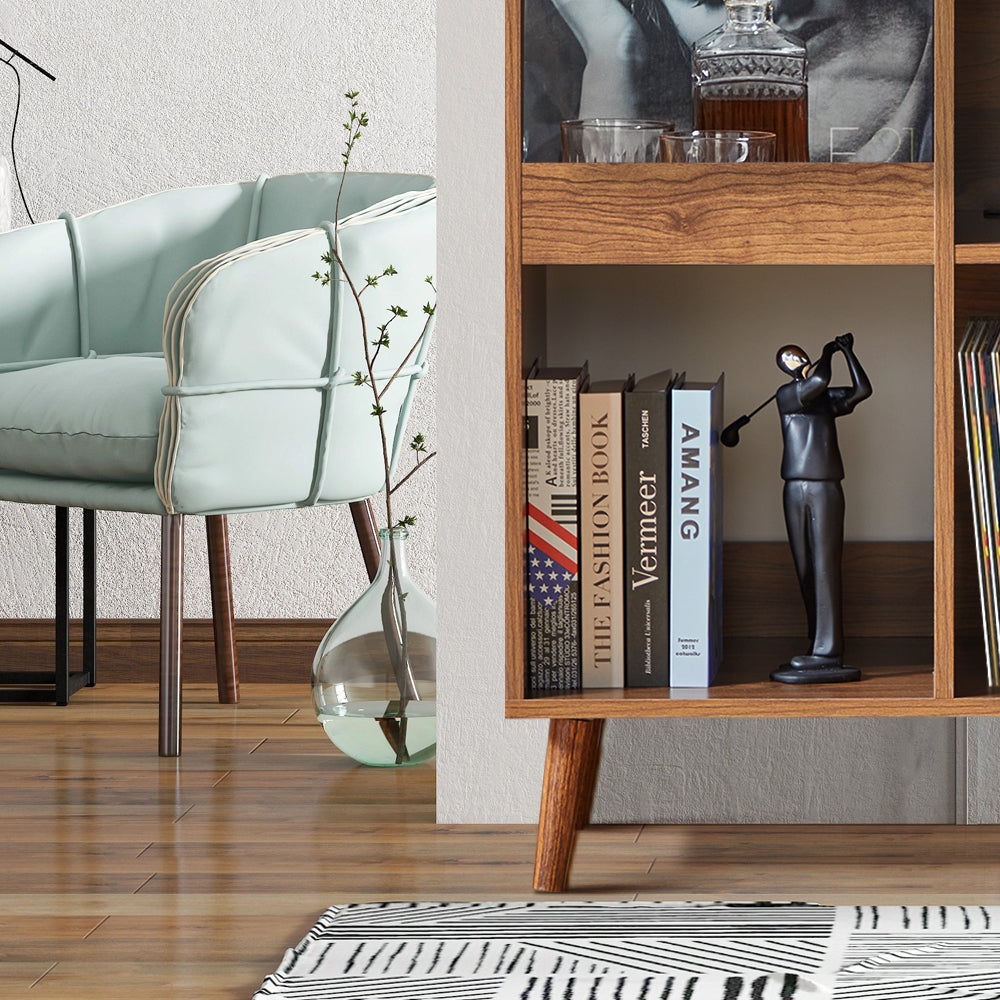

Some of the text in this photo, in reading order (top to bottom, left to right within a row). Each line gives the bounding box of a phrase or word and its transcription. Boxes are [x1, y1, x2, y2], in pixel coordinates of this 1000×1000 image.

[546, 477, 558, 487] A
[641, 410, 650, 449] TASCHEN
[680, 423, 700, 540] AMANG
[591, 413, 612, 669] THE FASHION BOOK
[632, 470, 659, 590] Vermeer
